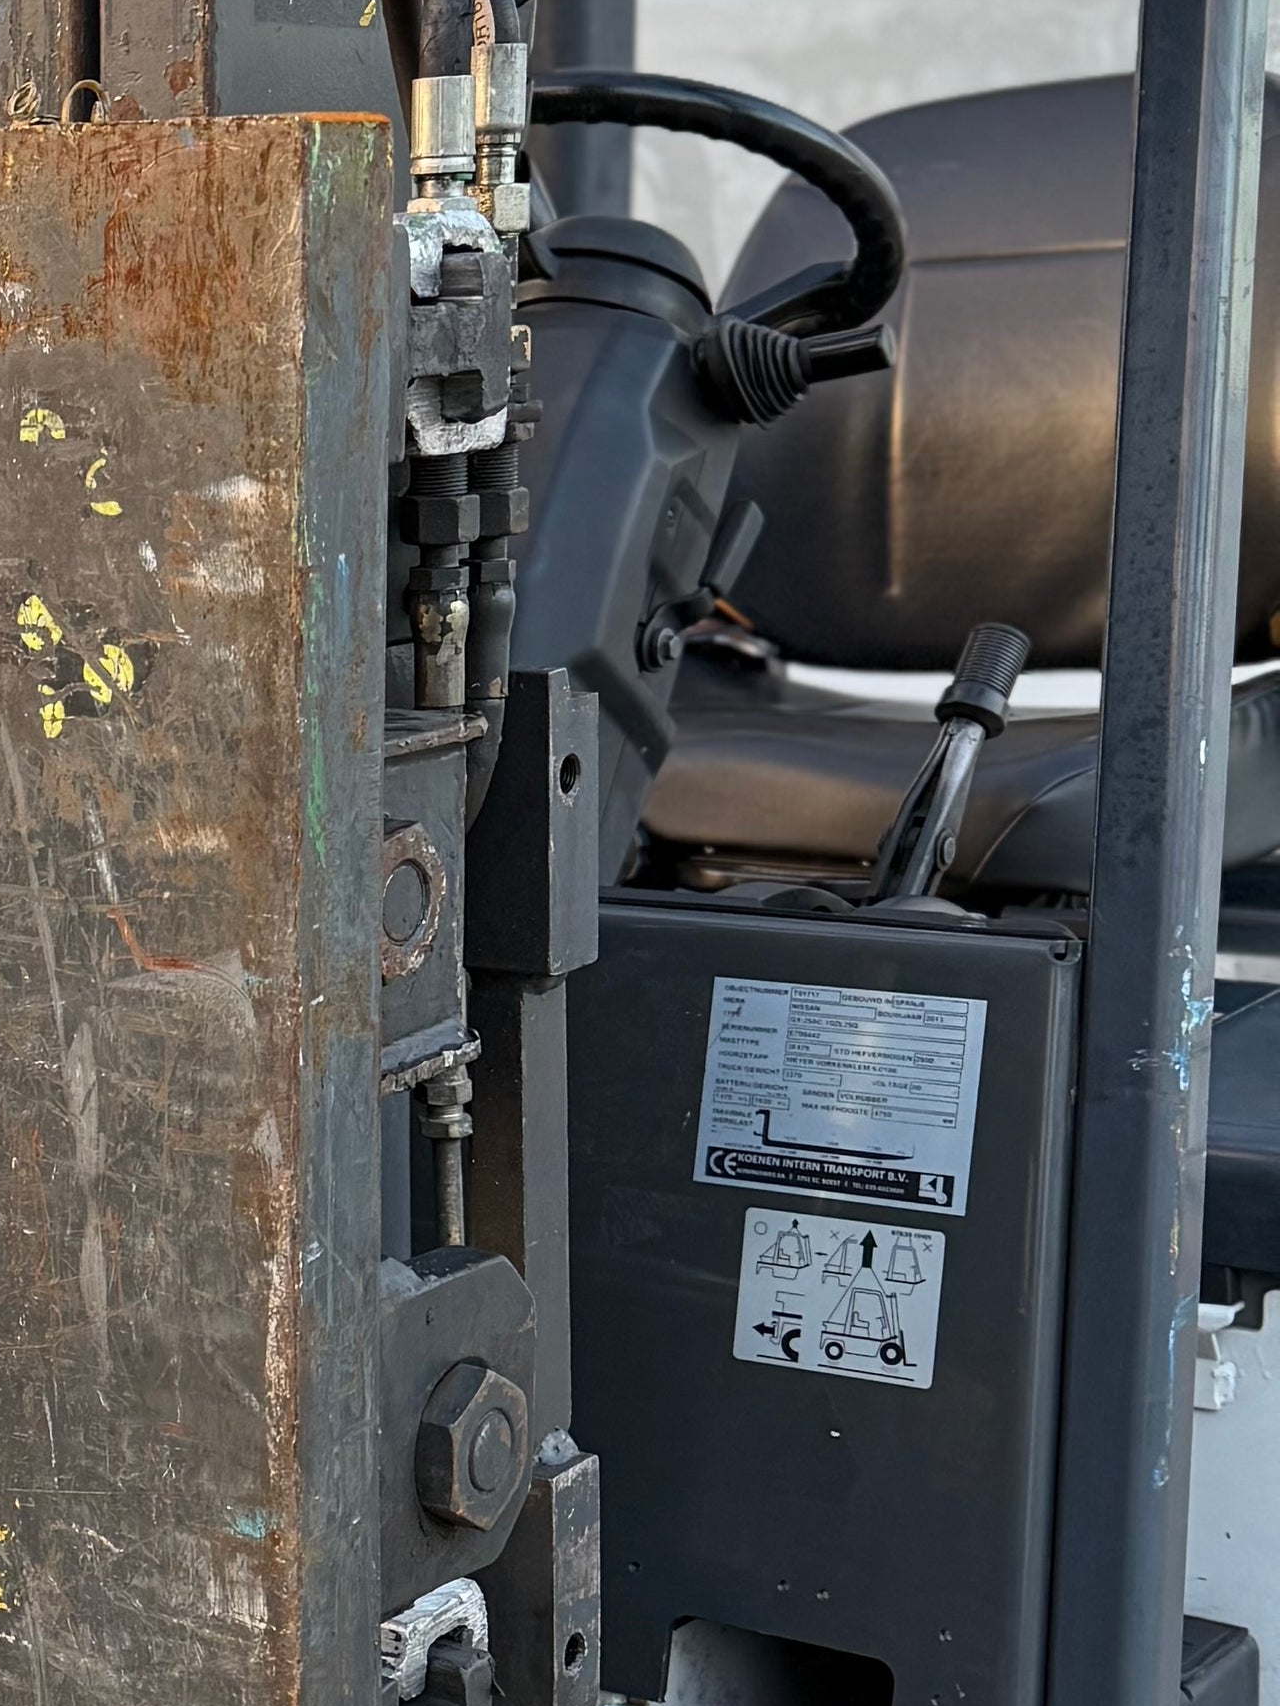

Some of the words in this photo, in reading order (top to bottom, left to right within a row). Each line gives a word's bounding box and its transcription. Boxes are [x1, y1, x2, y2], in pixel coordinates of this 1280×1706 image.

[791, 1003, 820, 1011] NISSAN
[708, 1150, 738, 1176] CE
[737, 1153, 780, 1167] KOENEN
[782, 1158, 821, 1172] INTERN
[822, 1163, 886, 1180] TRANSPORT
[886, 1171, 910, 1183] B.V.
